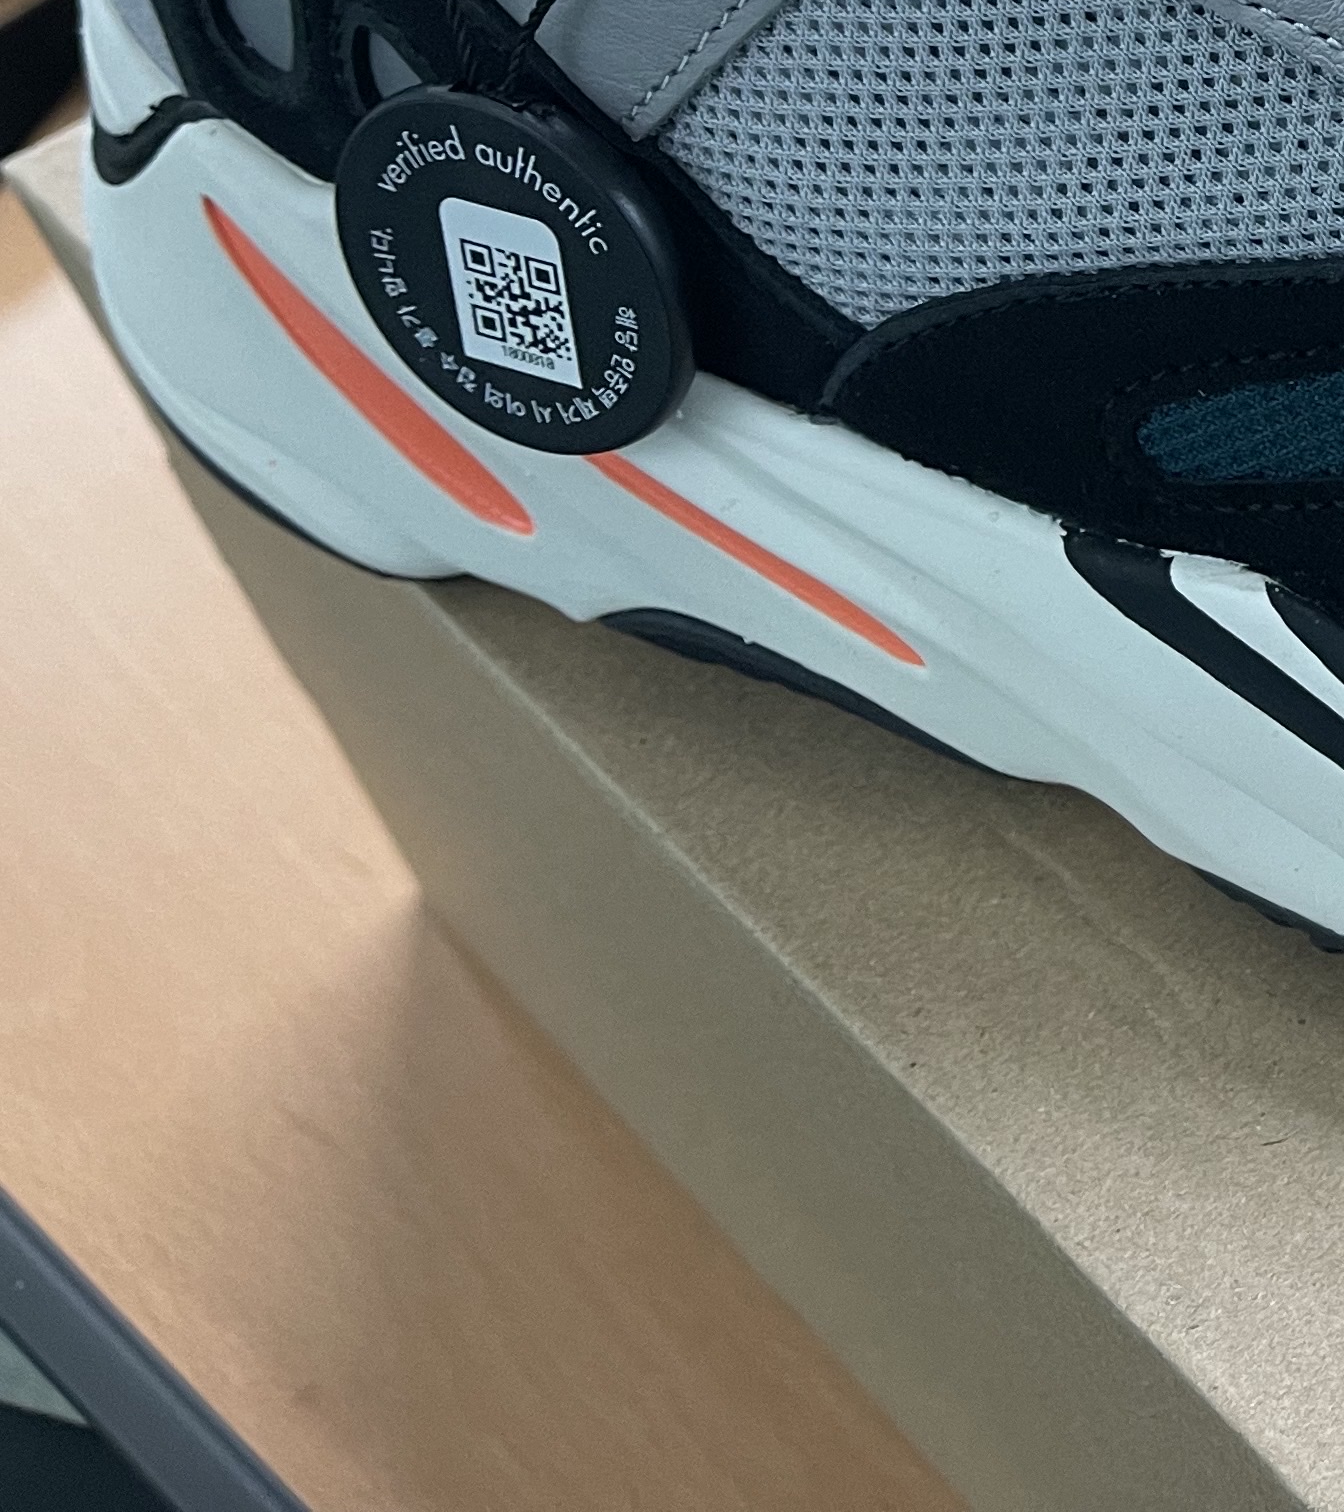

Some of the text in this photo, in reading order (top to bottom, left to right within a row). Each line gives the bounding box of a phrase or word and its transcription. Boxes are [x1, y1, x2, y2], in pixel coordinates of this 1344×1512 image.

[377, 125, 608, 255] verified authentic
[614, 306, 639, 352] 해당
[591, 354, 635, 409] 인증택
[531, 399, 552, 423] 시
[555, 397, 600, 425] 제거
